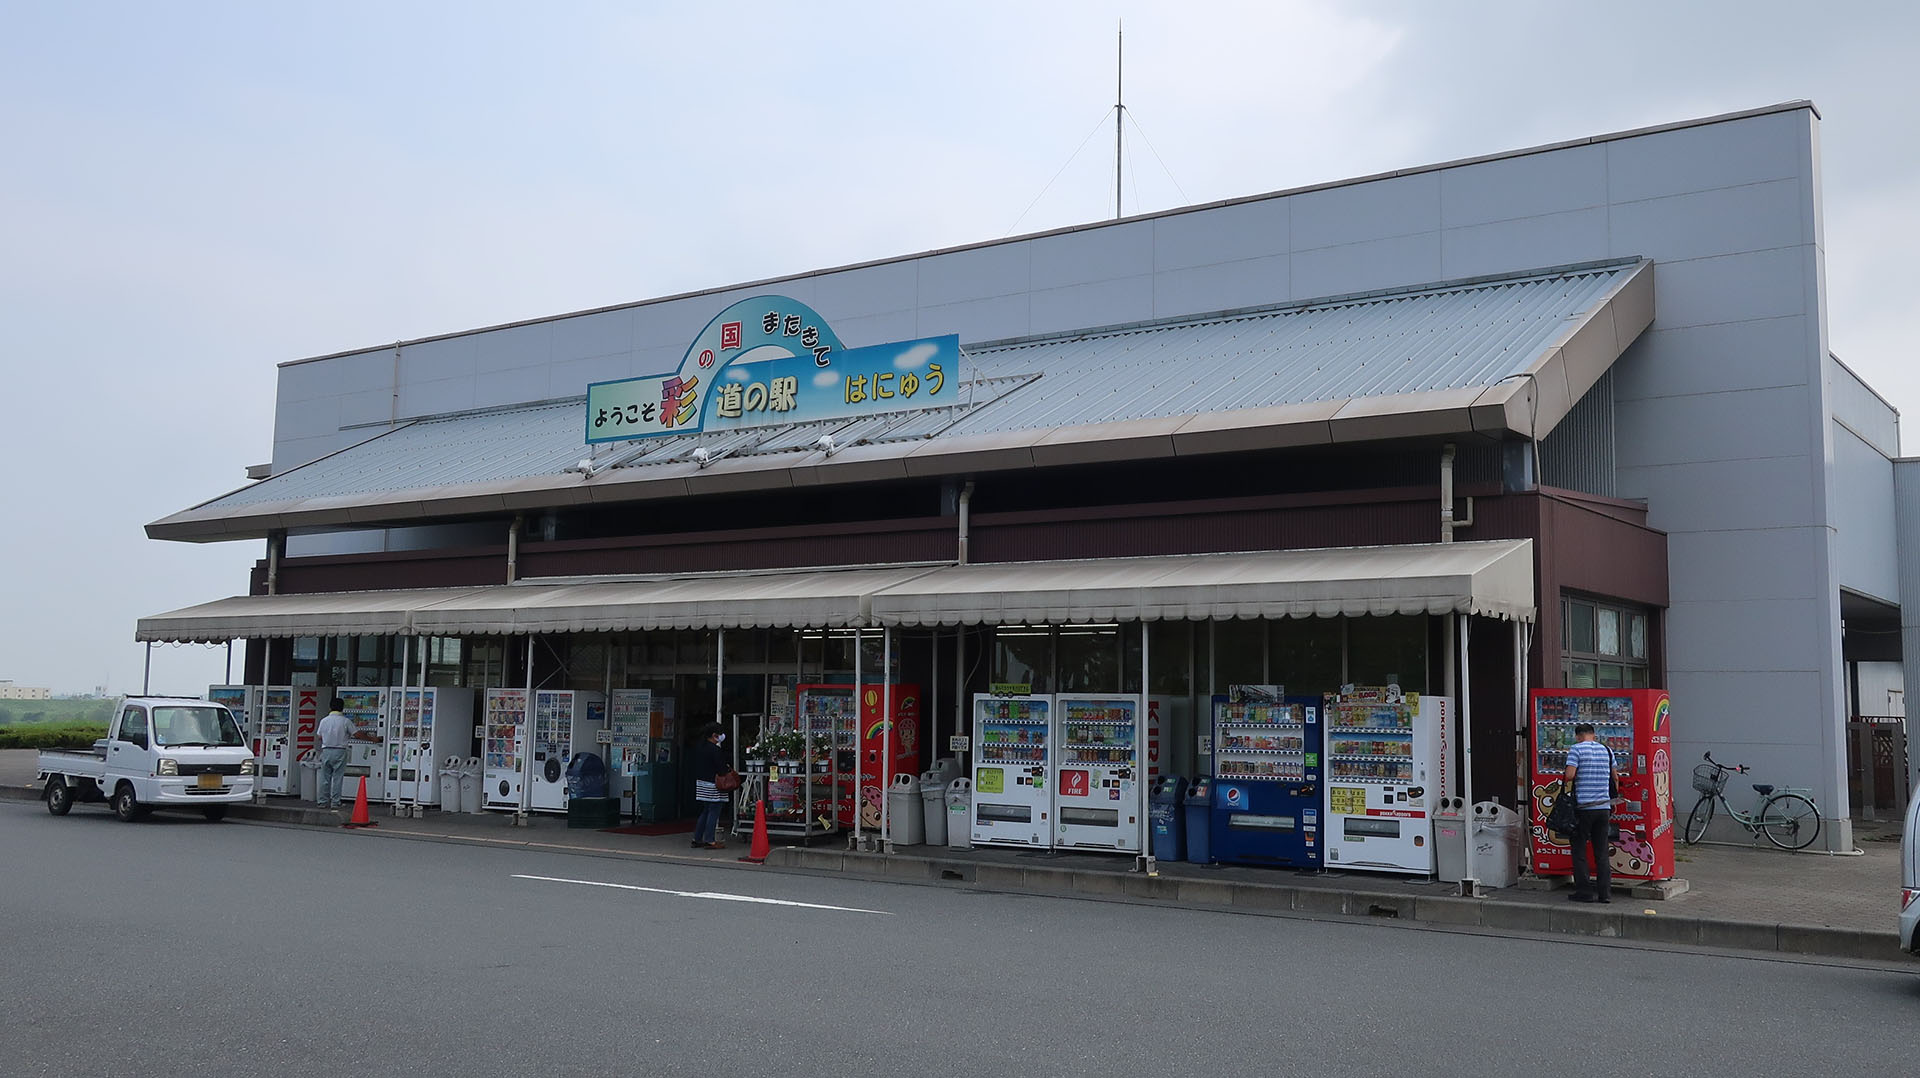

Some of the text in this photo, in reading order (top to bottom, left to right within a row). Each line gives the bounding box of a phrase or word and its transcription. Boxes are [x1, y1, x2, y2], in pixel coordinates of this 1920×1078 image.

[762, 311, 832, 368] またきて
[594, 402, 656, 429] ようこそ
[716, 363, 945, 419] 道の駅 はにゅう
